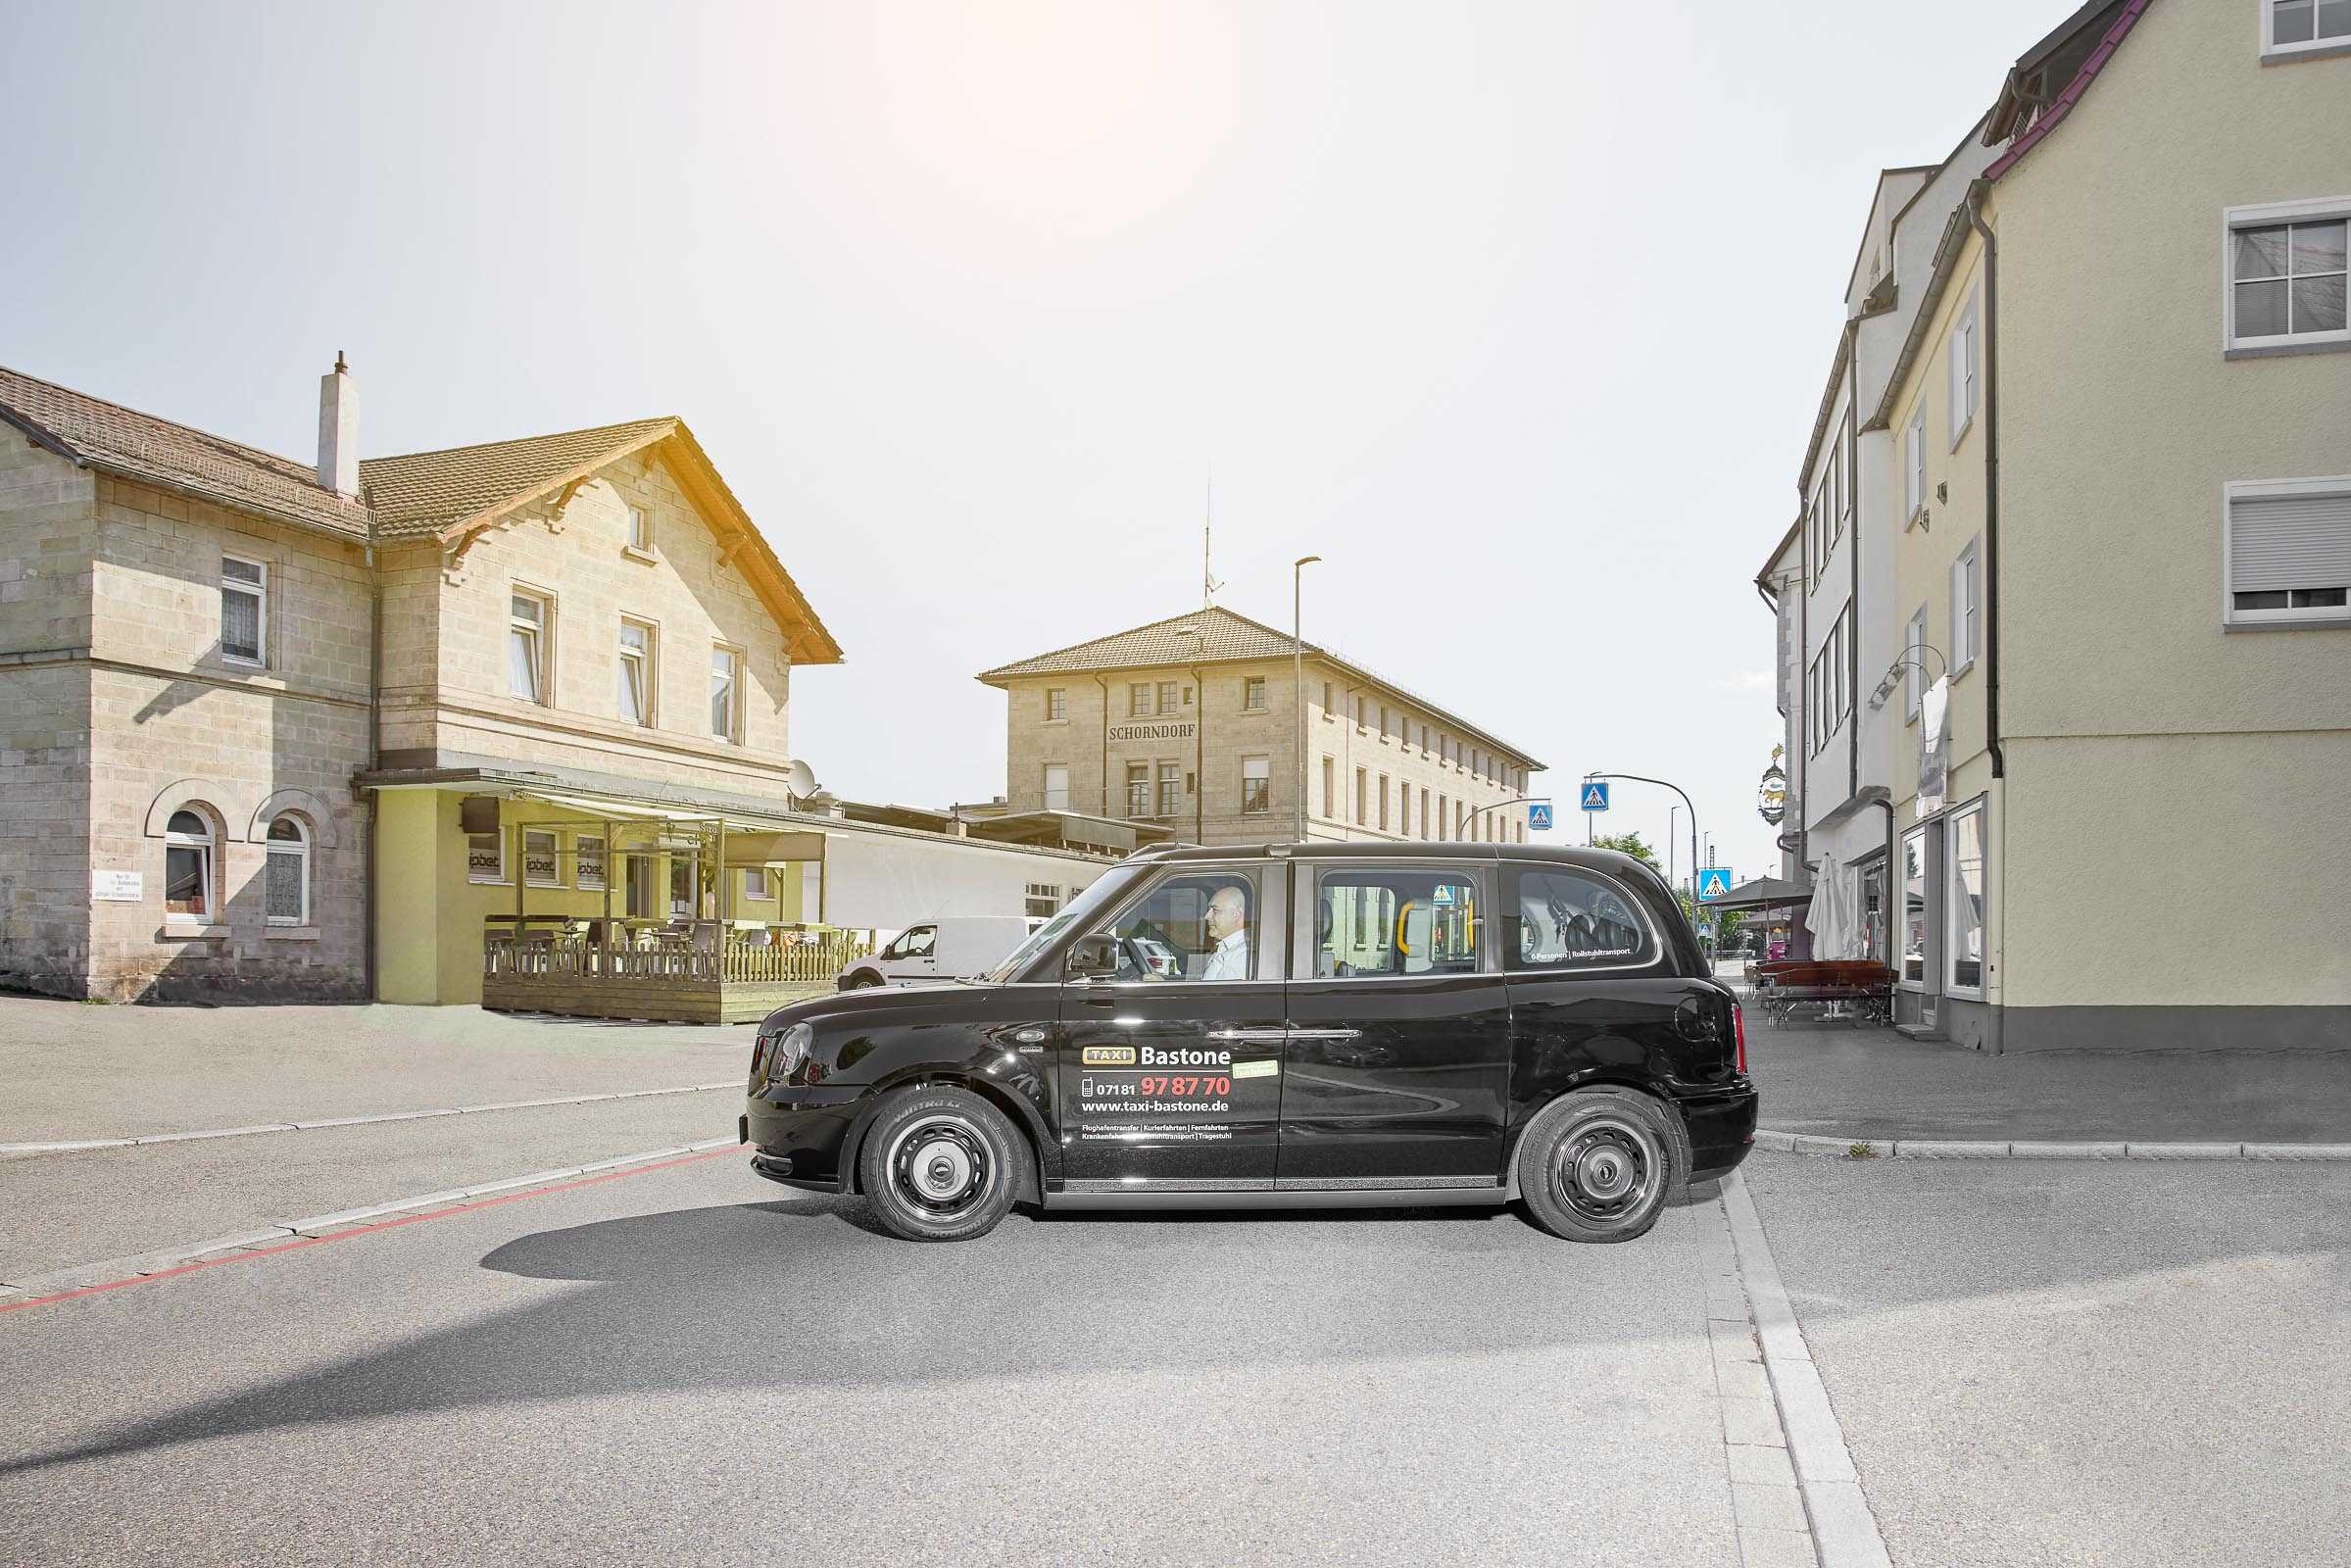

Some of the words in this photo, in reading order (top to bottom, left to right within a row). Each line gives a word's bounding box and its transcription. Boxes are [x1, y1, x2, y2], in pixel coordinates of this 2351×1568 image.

[1109, 724, 1195, 740] SCHORNDORF
[1537, 951, 1567, 959] Personen
[1572, 948, 1631, 957] Rollstuhltransport
[1091, 1051, 1127, 1060] TAXI
[1142, 1047, 1231, 1065] Bastone
[1082, 1101, 1229, 1112] www.taxi-bastone.de
